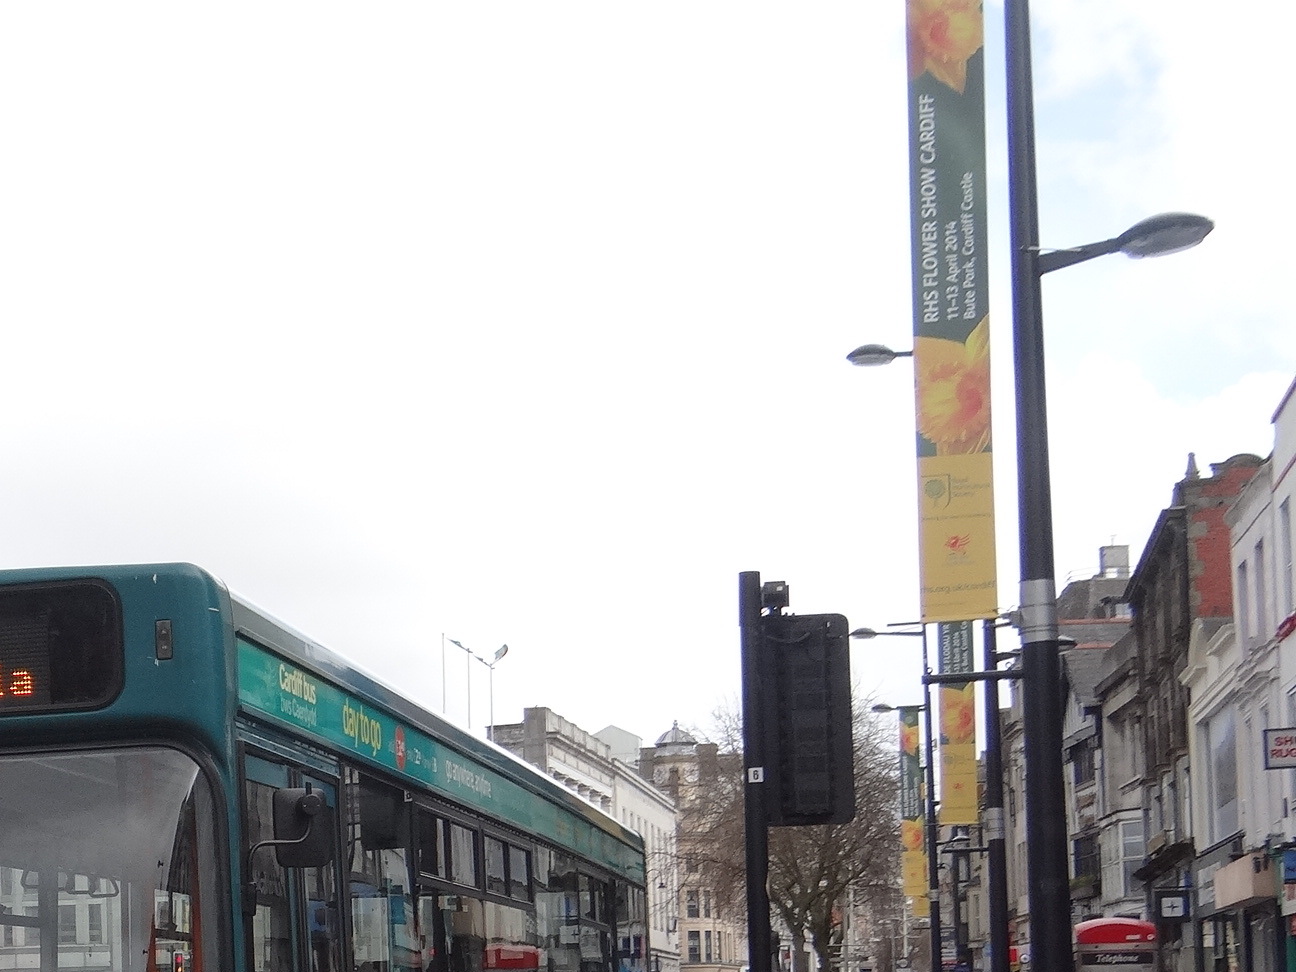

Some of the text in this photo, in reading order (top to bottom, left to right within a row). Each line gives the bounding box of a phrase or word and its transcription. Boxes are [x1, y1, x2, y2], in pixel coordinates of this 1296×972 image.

[918, 94, 940, 323] RHS FLOWER SHOW CARDIFF
[960, 172, 974, 209] Castle
[945, 221, 958, 254] 2014
[961, 209, 975, 255] Cardiff
[945, 255, 960, 287] April
[963, 292, 975, 320] Bute
[279, 663, 317, 706] Cardiff bus
[342, 697, 359, 748] day
[359, 704, 370, 745] to
[370, 719, 382, 757] go
[1095, 953, 1140, 965] Telephone
